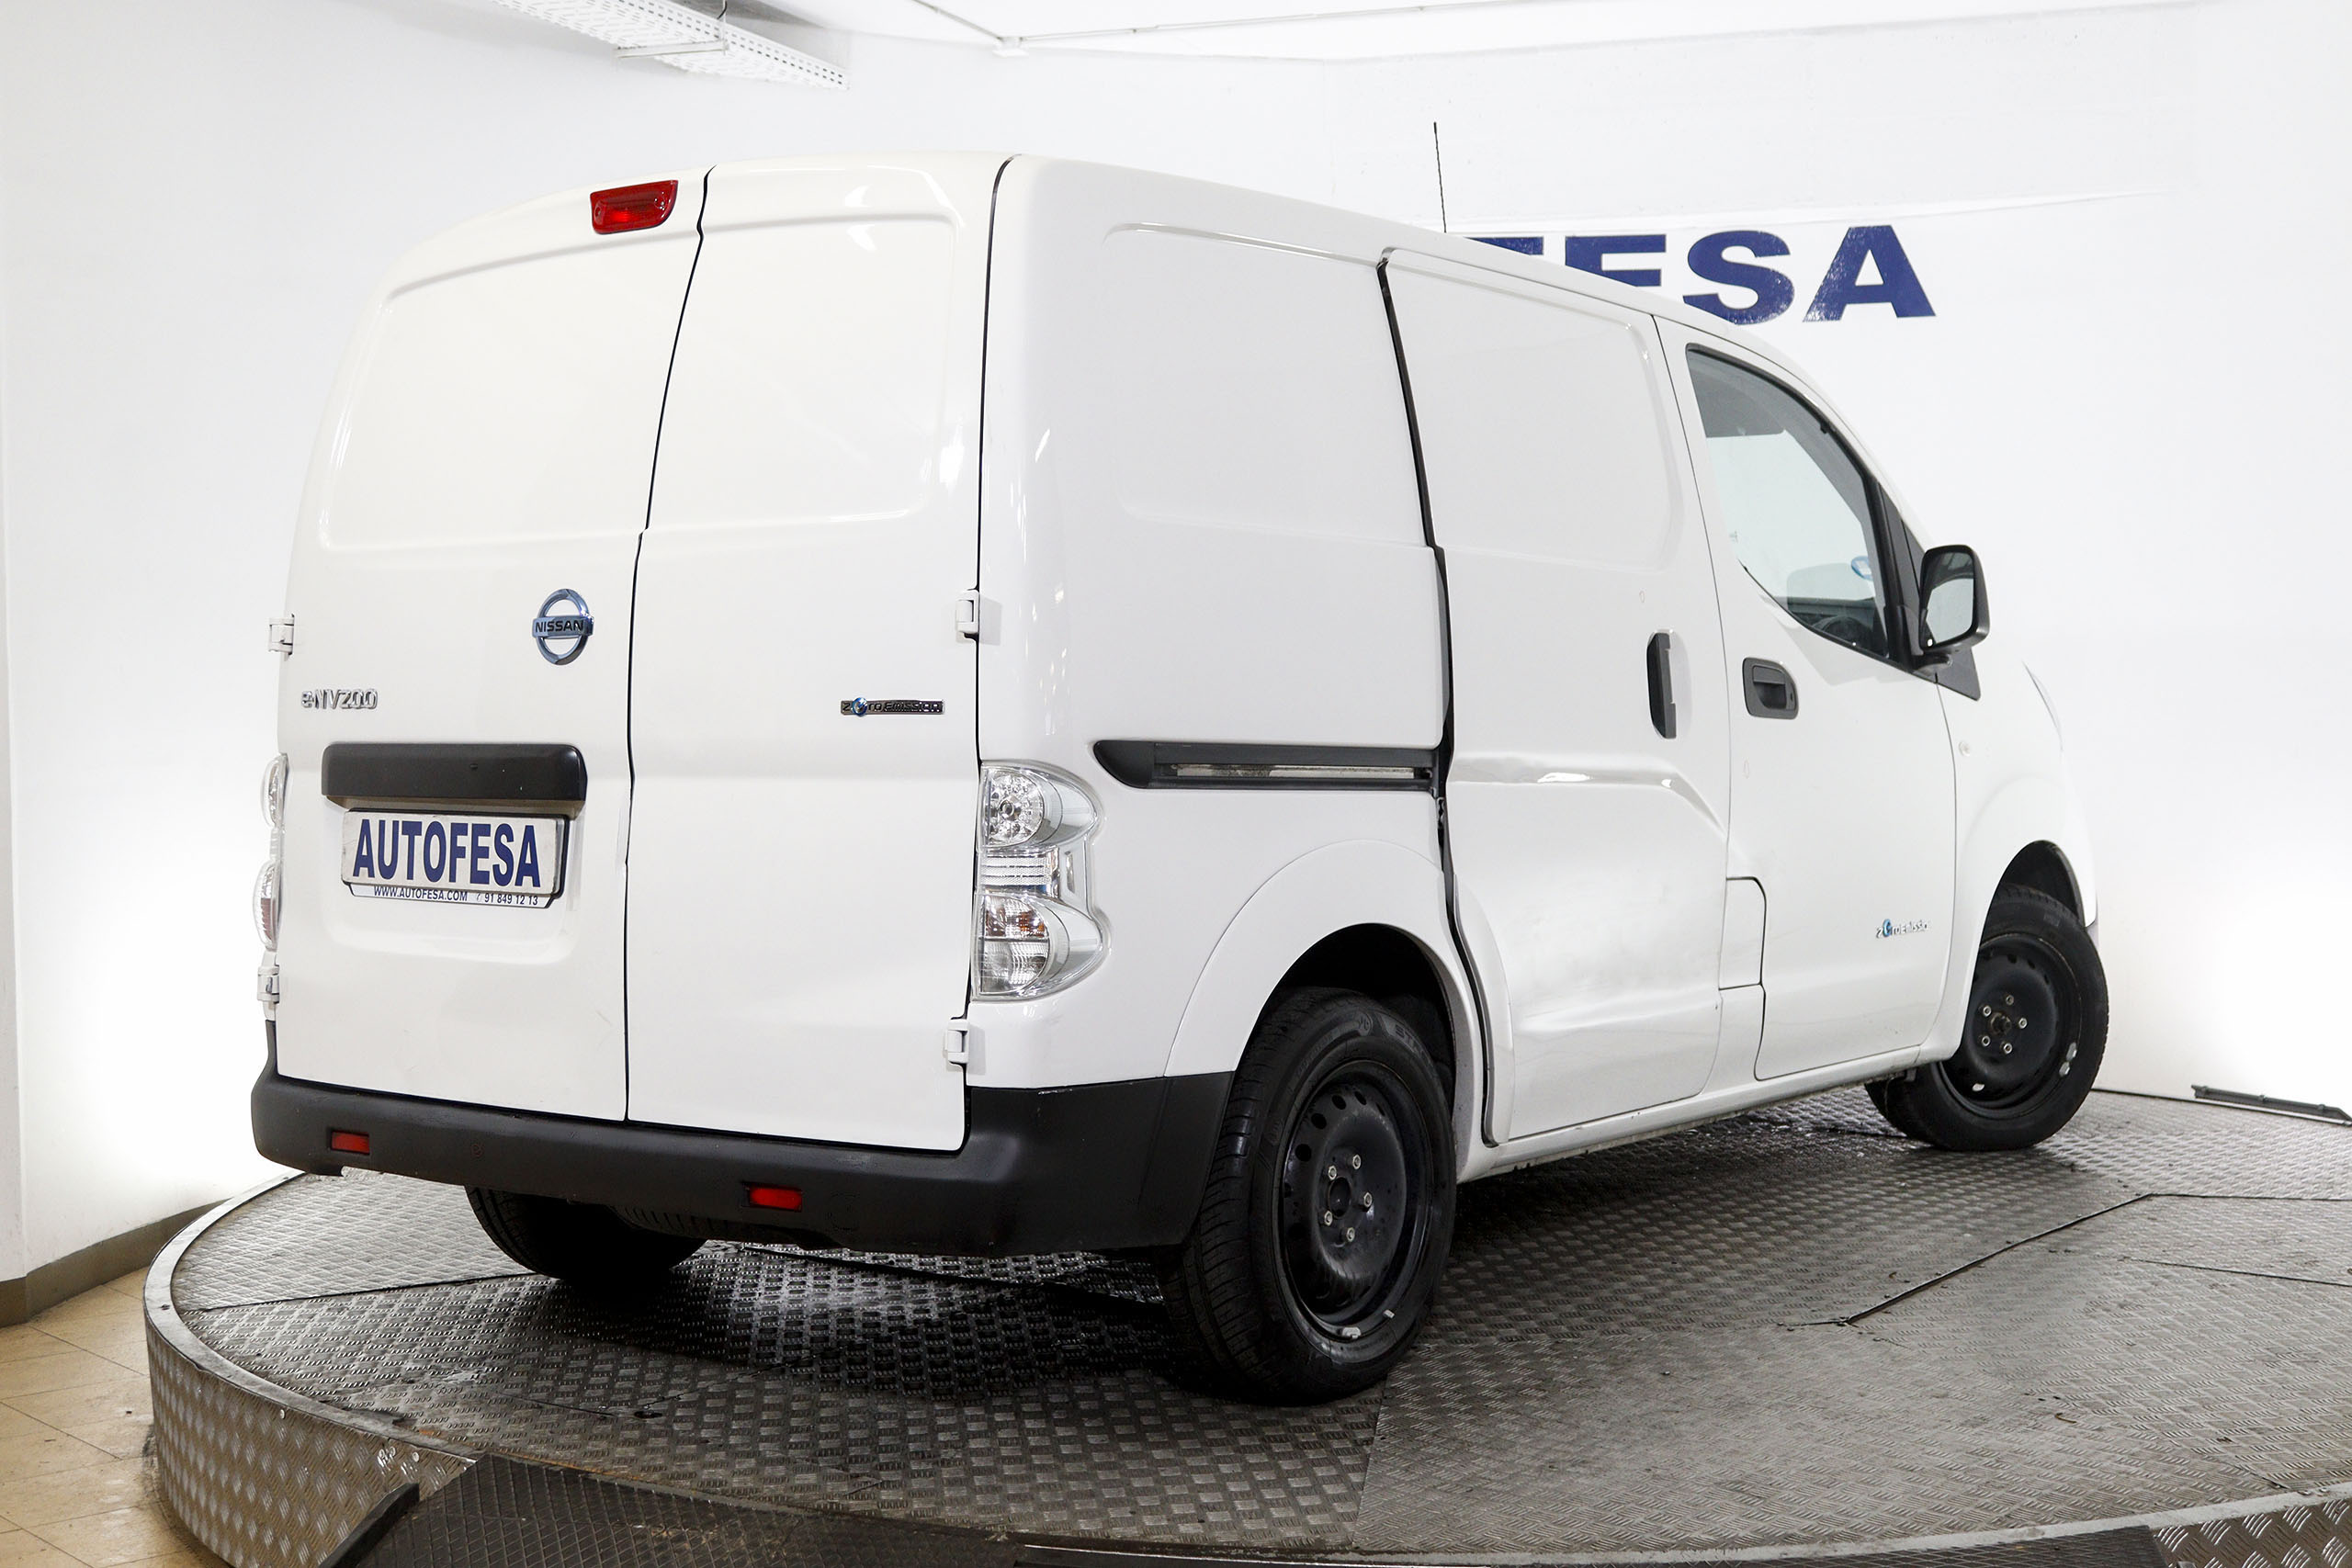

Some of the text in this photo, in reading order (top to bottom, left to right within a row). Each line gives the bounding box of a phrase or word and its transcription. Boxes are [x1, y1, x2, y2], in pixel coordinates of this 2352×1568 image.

[1464, 225, 1937, 325] ESA
[535, 619, 584, 633] NISSAN
[353, 818, 541, 887] AUTOFESA
[374, 886, 538, 906] WWW.AUTOFESA.COM 91 849 12 13
